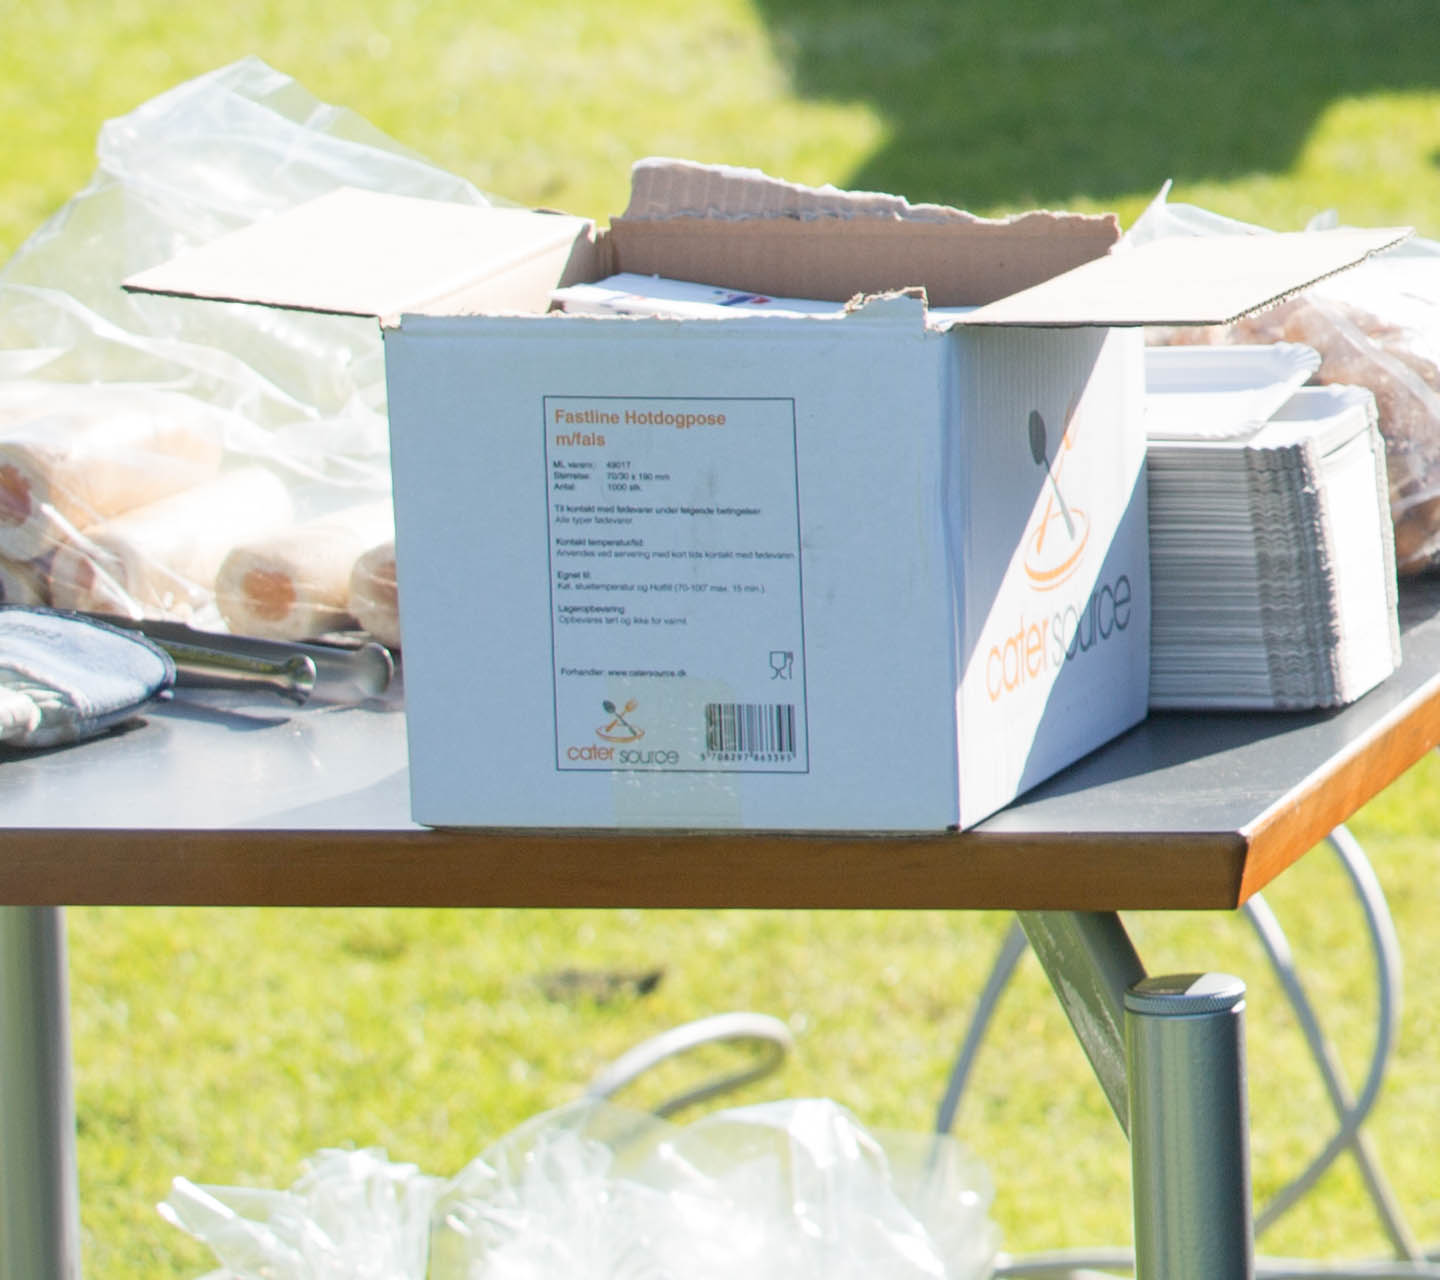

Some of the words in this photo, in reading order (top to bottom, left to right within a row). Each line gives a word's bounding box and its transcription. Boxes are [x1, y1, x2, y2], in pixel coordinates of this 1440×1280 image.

[555, 409, 620, 425] Fastline
[625, 410, 727, 429] Hotdogpose
[556, 432, 606, 447] m/fals
[608, 483, 628, 491] 1000
[566, 505, 595, 513] kontakt
[597, 505, 615, 513] med
[655, 506, 678, 514] under
[572, 517, 592, 526] typer
[986, 615, 1048, 703] cater
[1052, 575, 1132, 667] source
[567, 744, 615, 761] cater
[619, 750, 680, 765] source
